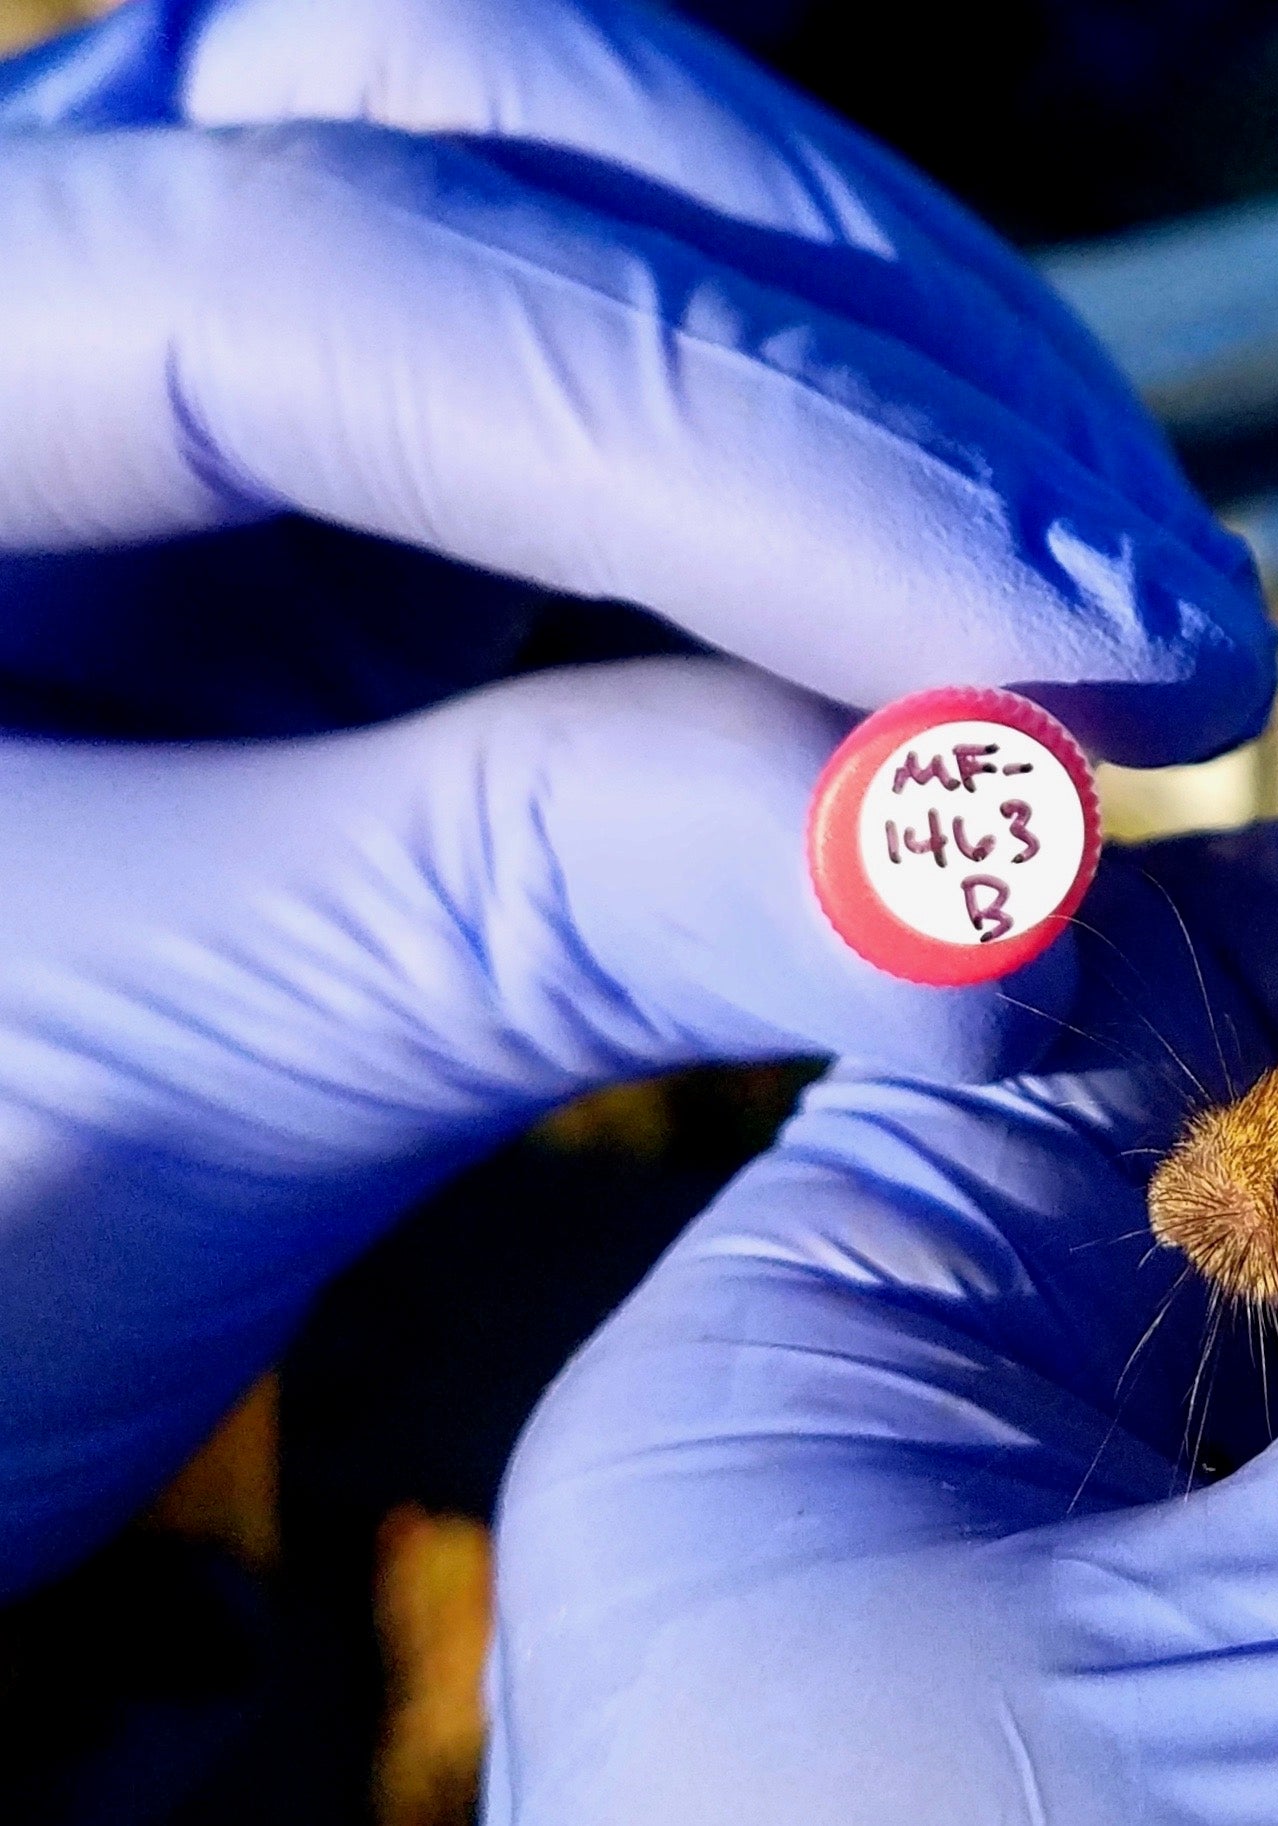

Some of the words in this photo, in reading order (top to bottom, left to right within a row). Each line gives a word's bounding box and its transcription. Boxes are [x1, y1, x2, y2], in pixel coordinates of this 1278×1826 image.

[892, 743, 1034, 794] MF-
[885, 799, 1041, 869] 1463
[960, 873, 1014, 943] B
